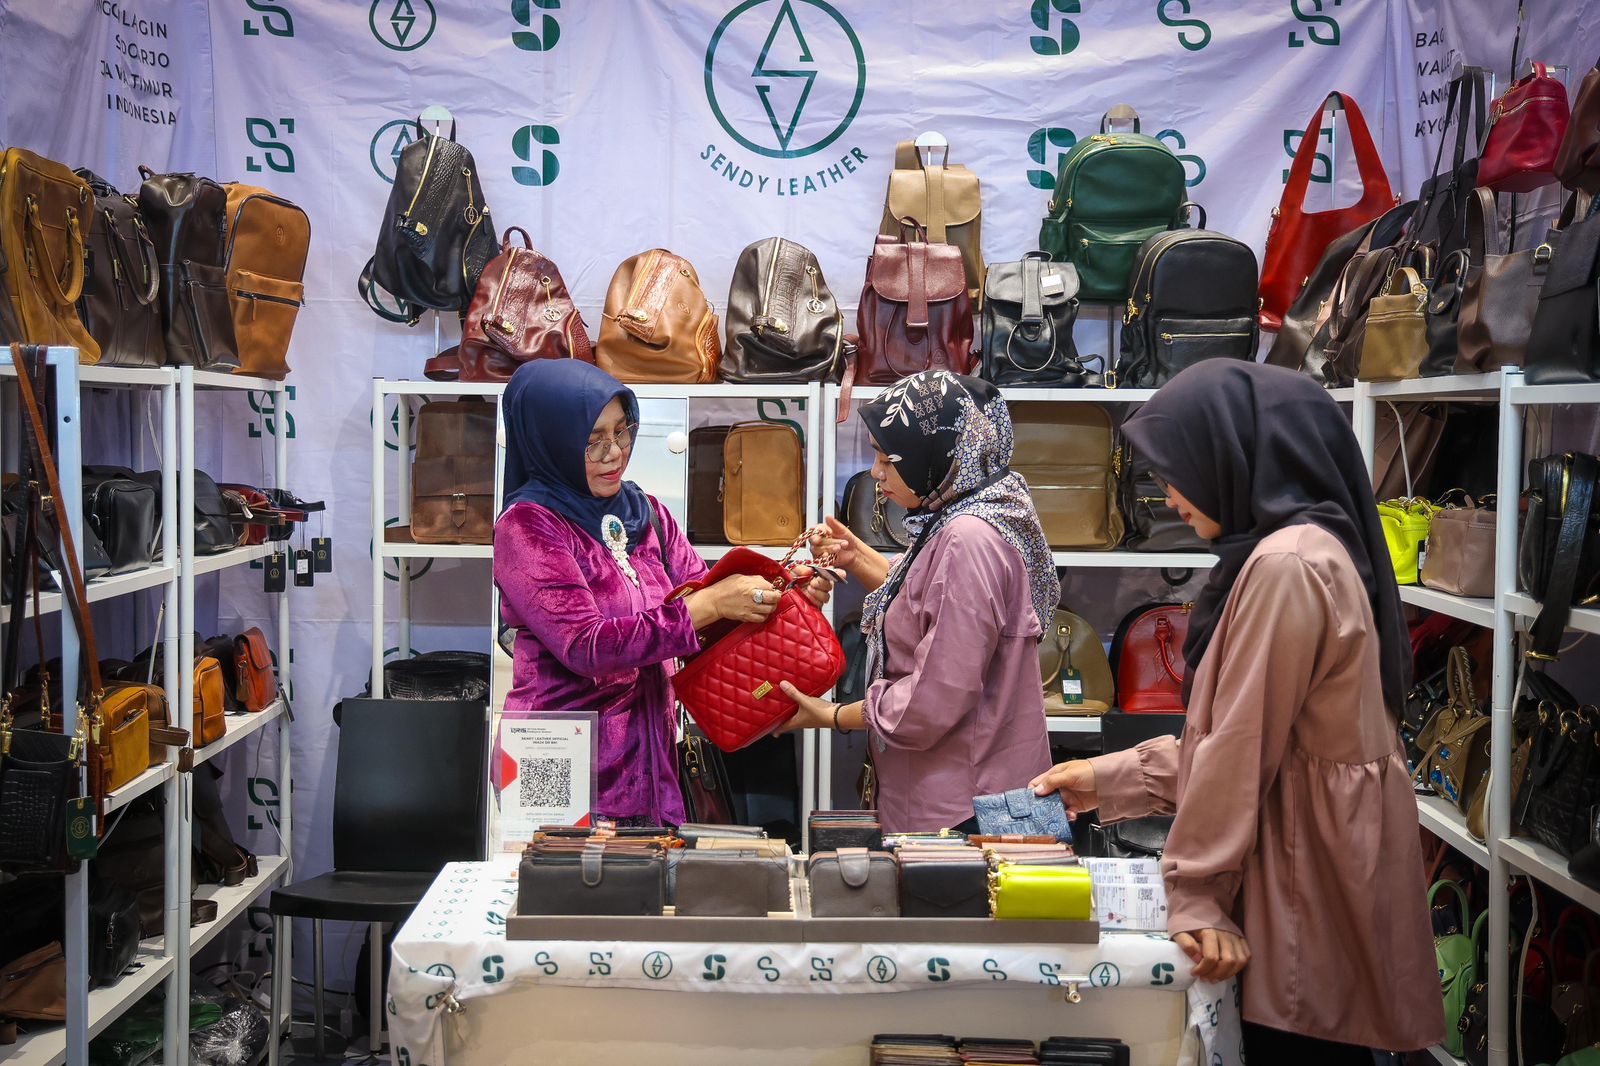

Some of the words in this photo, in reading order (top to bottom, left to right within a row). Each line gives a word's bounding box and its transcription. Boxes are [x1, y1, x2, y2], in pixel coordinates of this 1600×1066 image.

[131, 74, 173, 98] TIMUR
[107, 93, 177, 126] INDONESIA
[700, 144, 770, 194] SENDY
[777, 145, 869, 197] LEATHER
